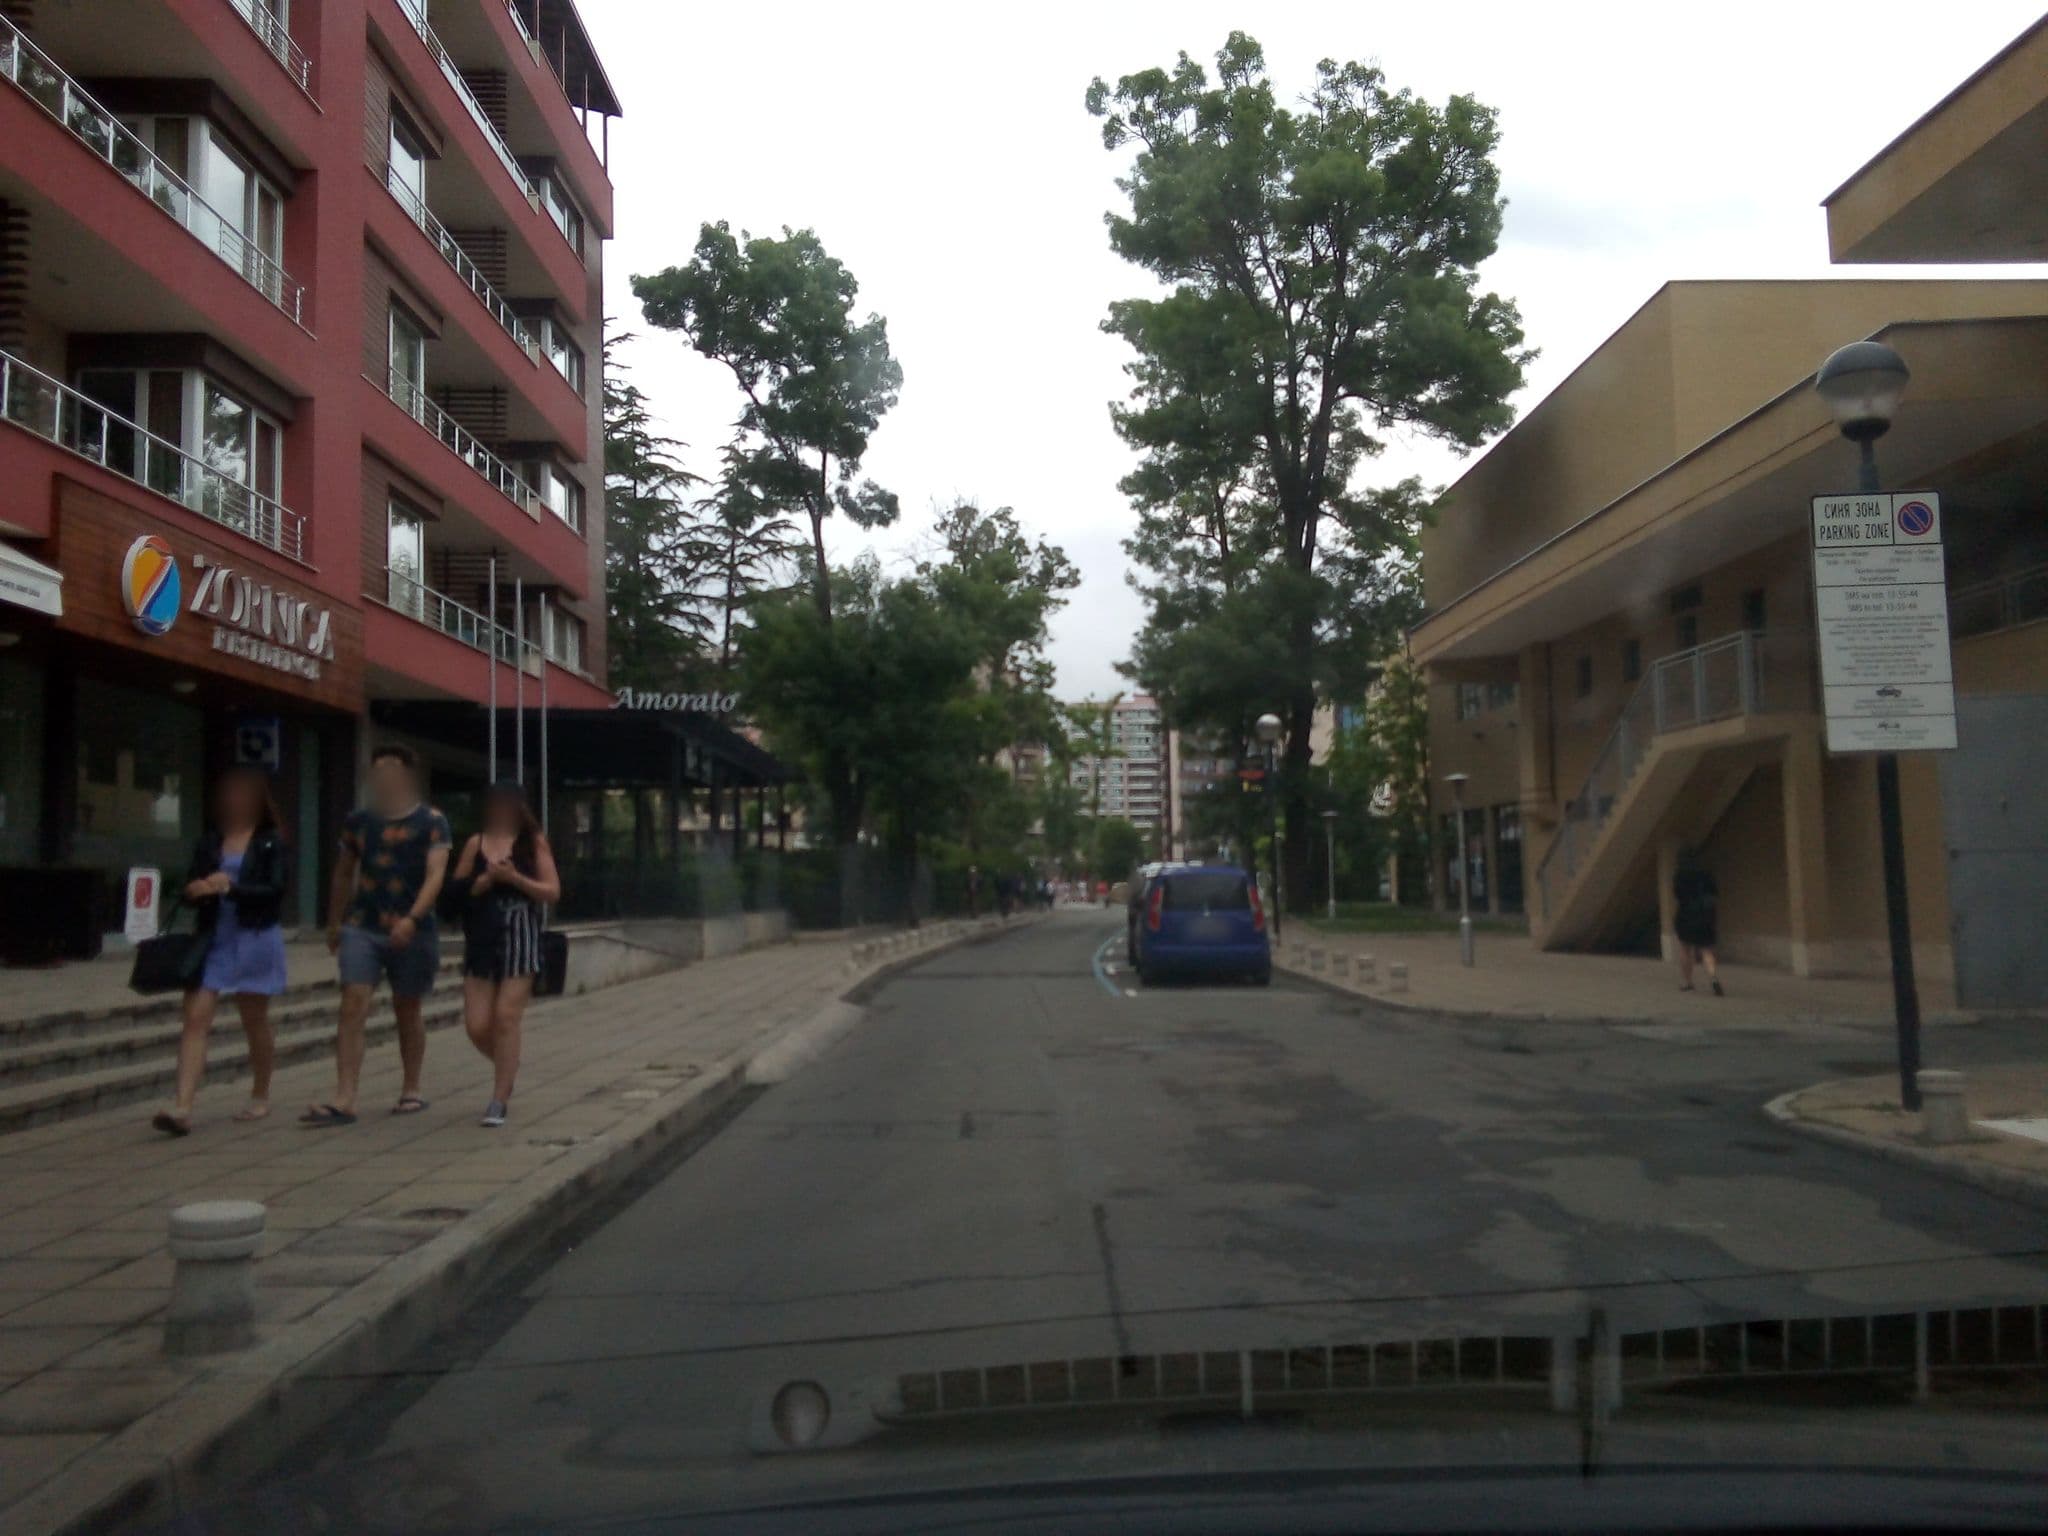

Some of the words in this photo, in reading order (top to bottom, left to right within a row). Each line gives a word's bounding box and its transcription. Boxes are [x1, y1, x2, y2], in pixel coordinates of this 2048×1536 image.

[1824, 502, 1850, 519] СИНЯ
[1856, 501, 1881, 518] ЗОНА
[1820, 523, 1860, 540] PARKING
[1865, 522, 1890, 539] ZONE
[190, 554, 335, 662] ZORNICA
[607, 686, 741, 712] Amorato
